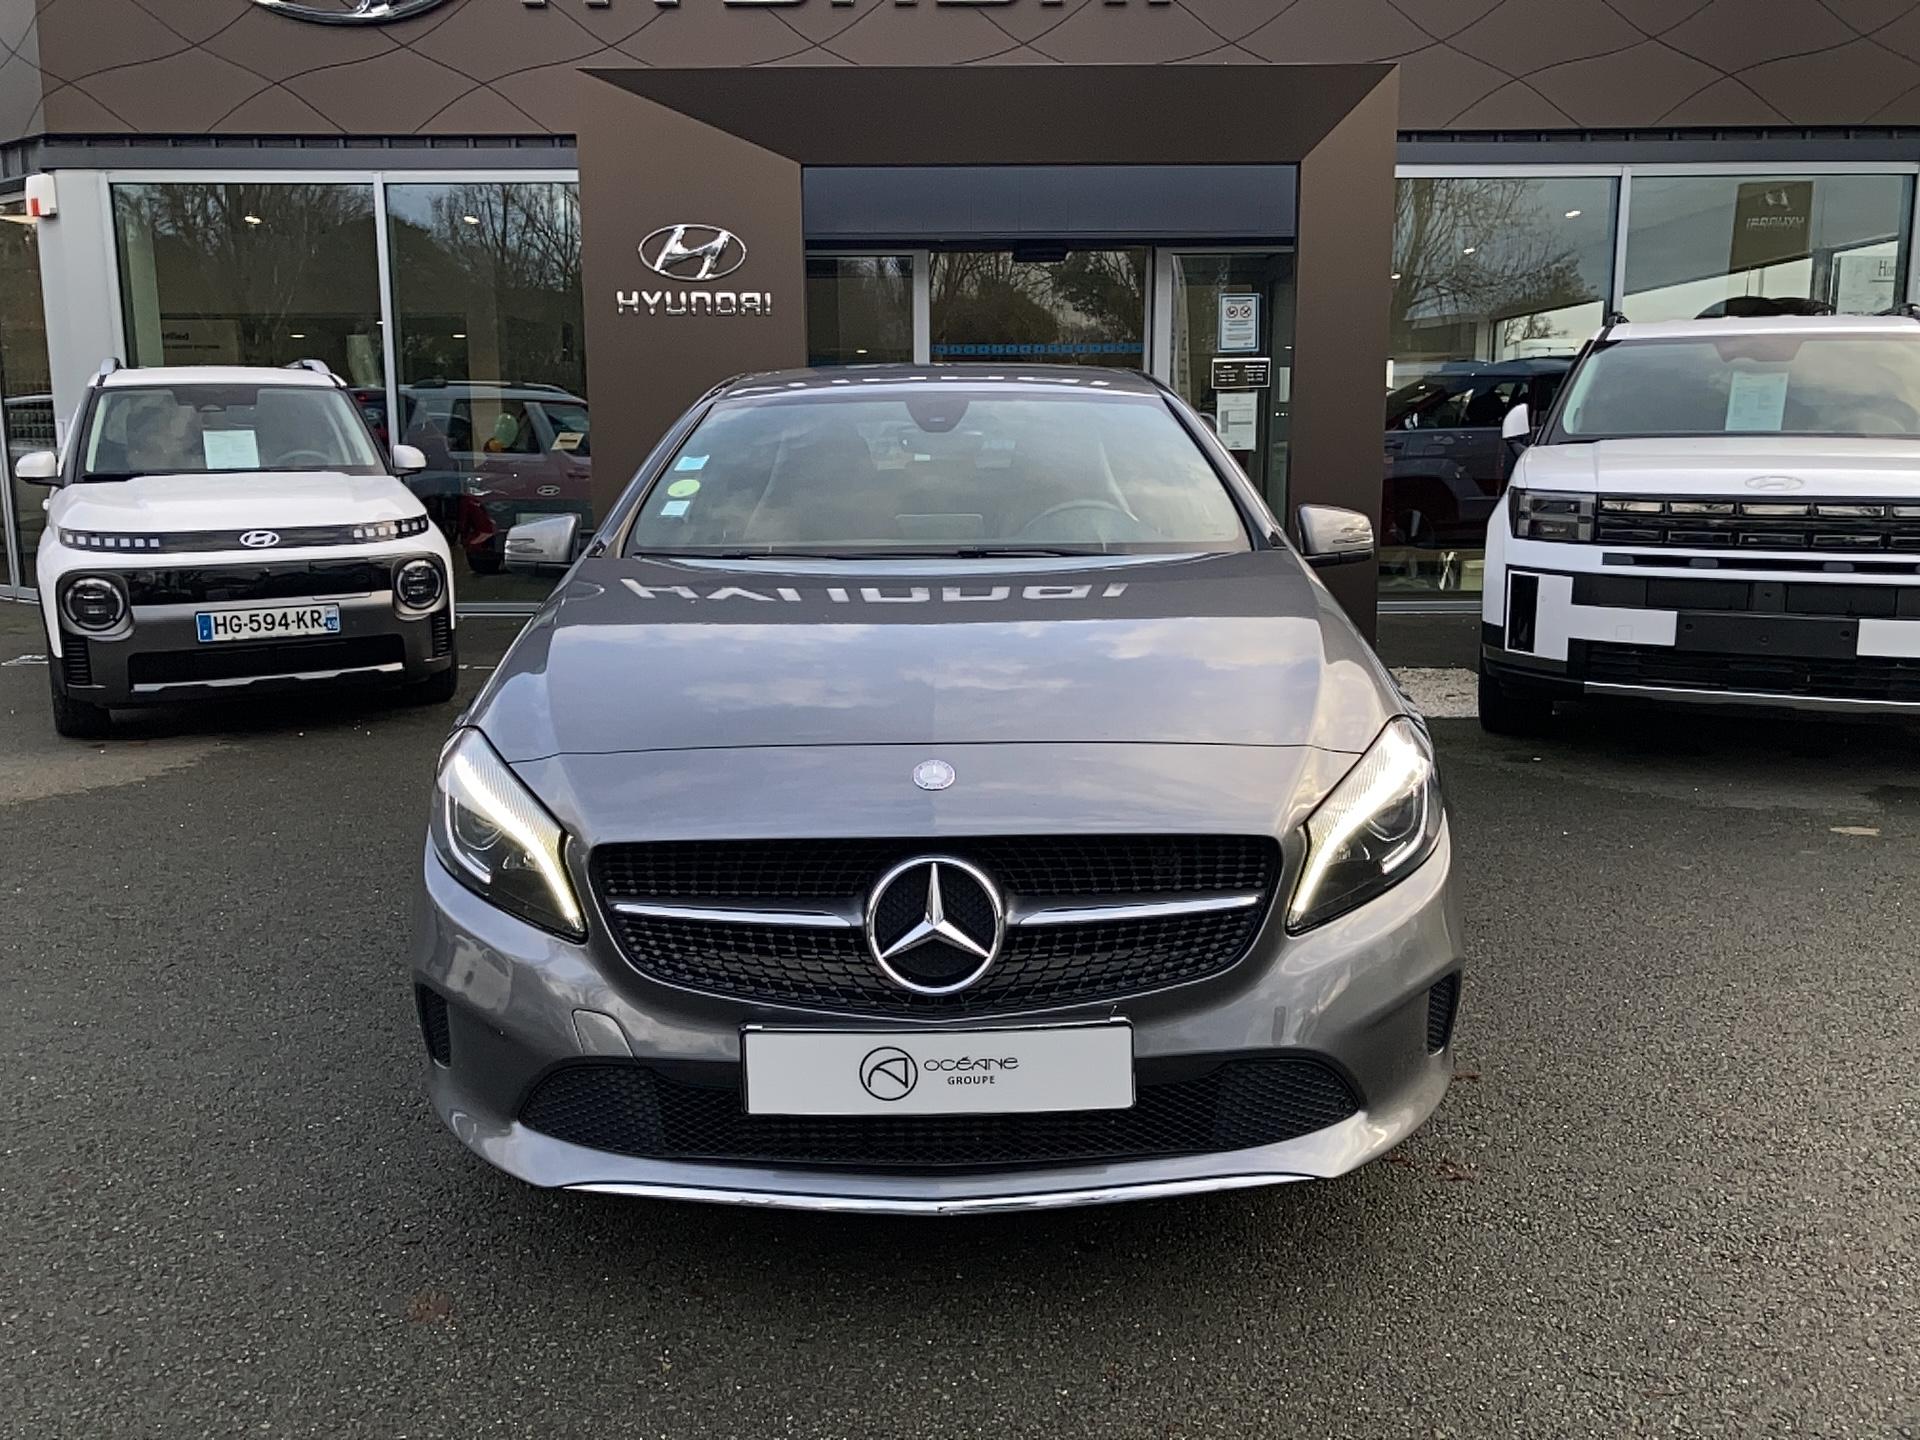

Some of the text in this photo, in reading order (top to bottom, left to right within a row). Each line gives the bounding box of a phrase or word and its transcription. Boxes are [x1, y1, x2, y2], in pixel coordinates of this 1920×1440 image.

[616, 291, 772, 315] HYUNDAI
[213, 610, 322, 635] HG-594-KR
[947, 1075, 995, 1085] GROUPE
